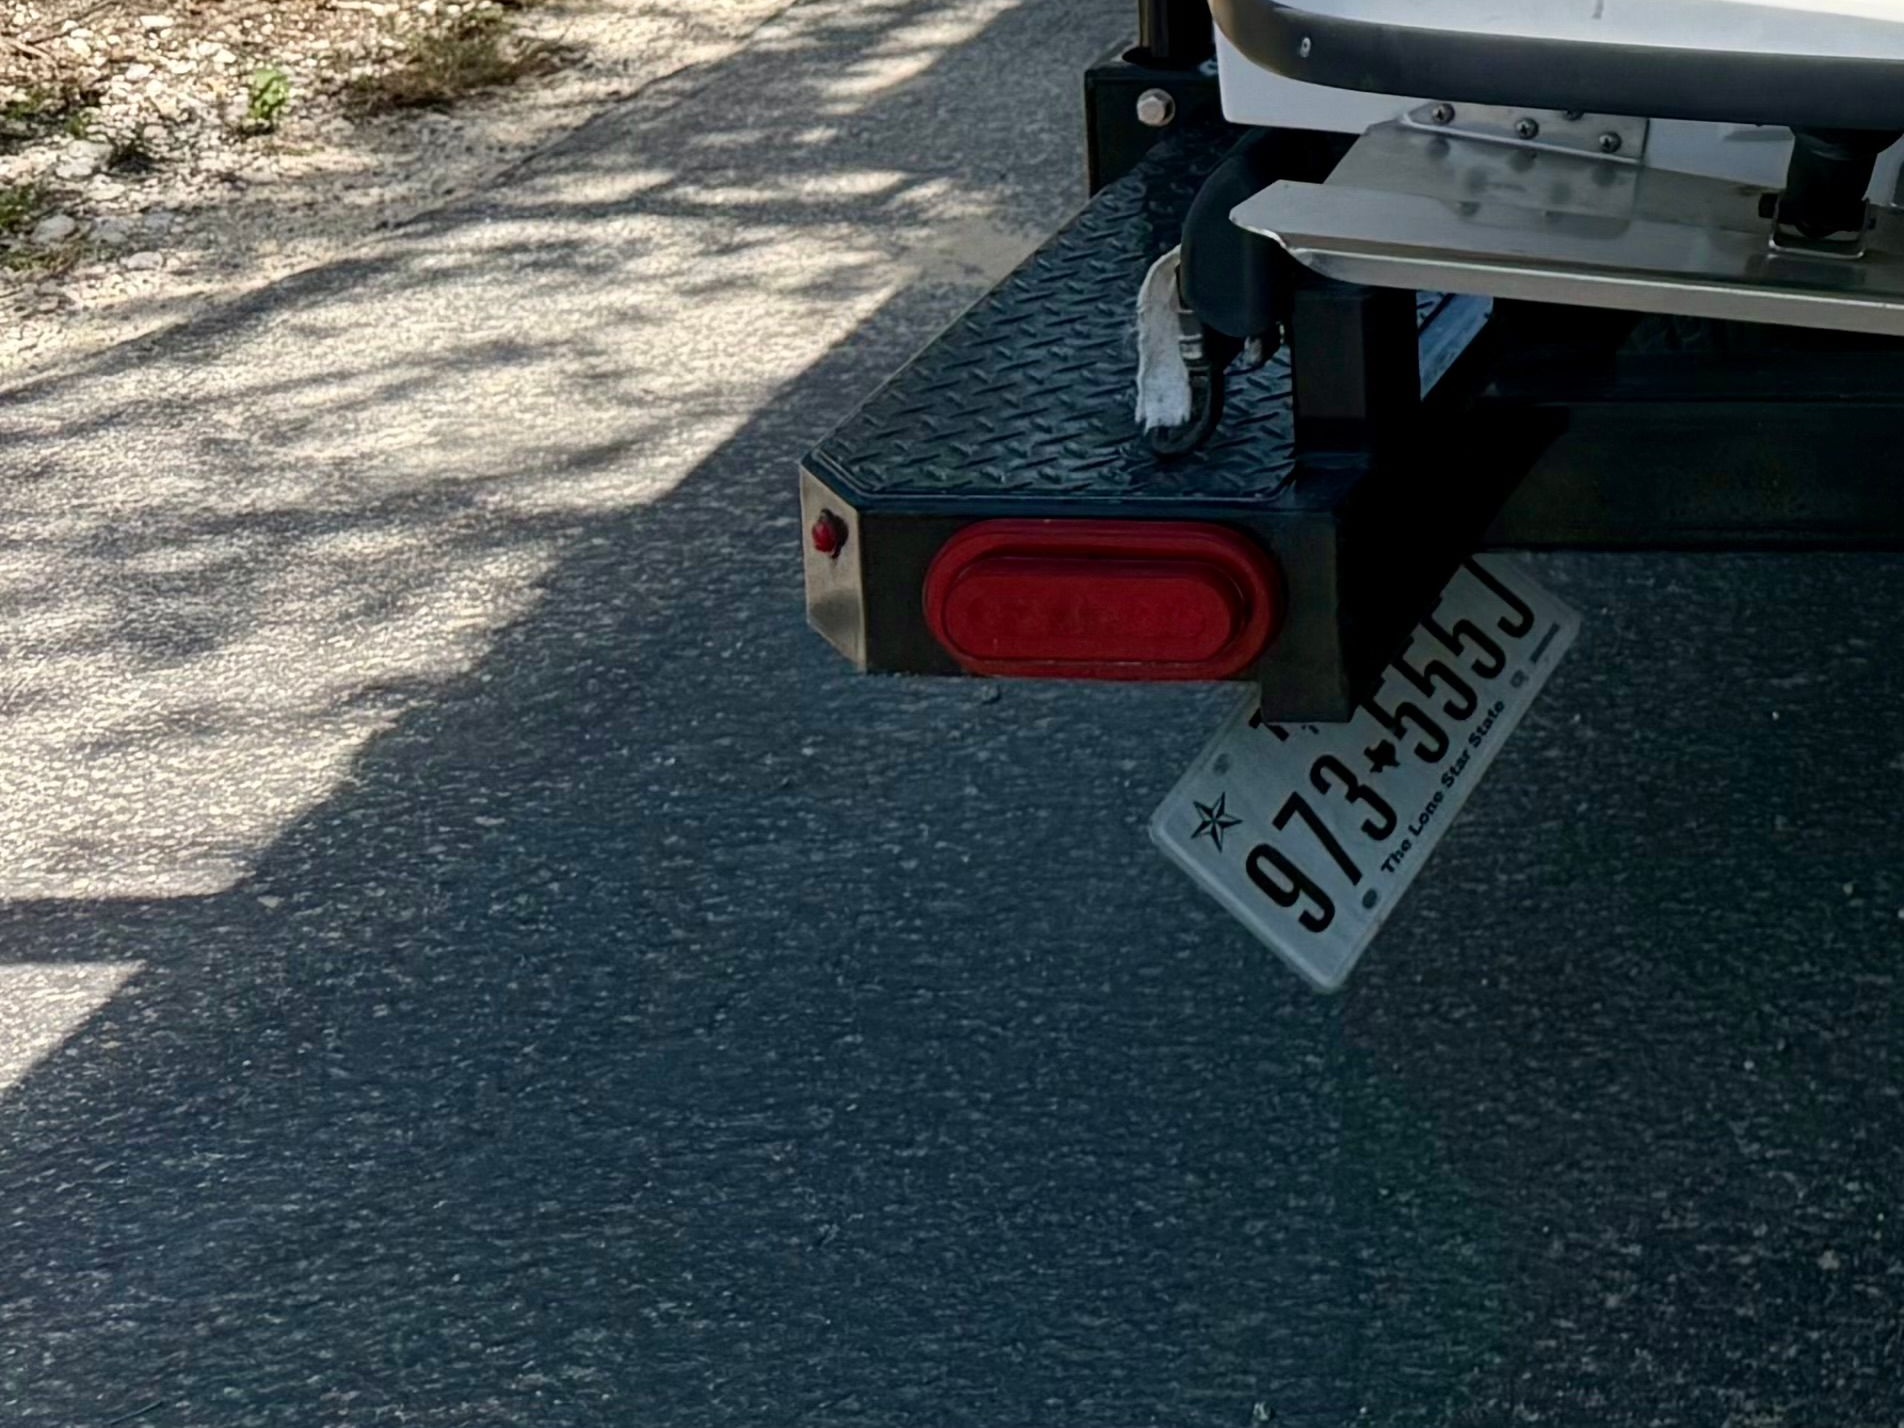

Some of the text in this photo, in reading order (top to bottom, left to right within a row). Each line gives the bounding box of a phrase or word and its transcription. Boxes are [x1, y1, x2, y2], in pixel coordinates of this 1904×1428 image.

[1381, 700, 1506, 873] The Lone Star State
